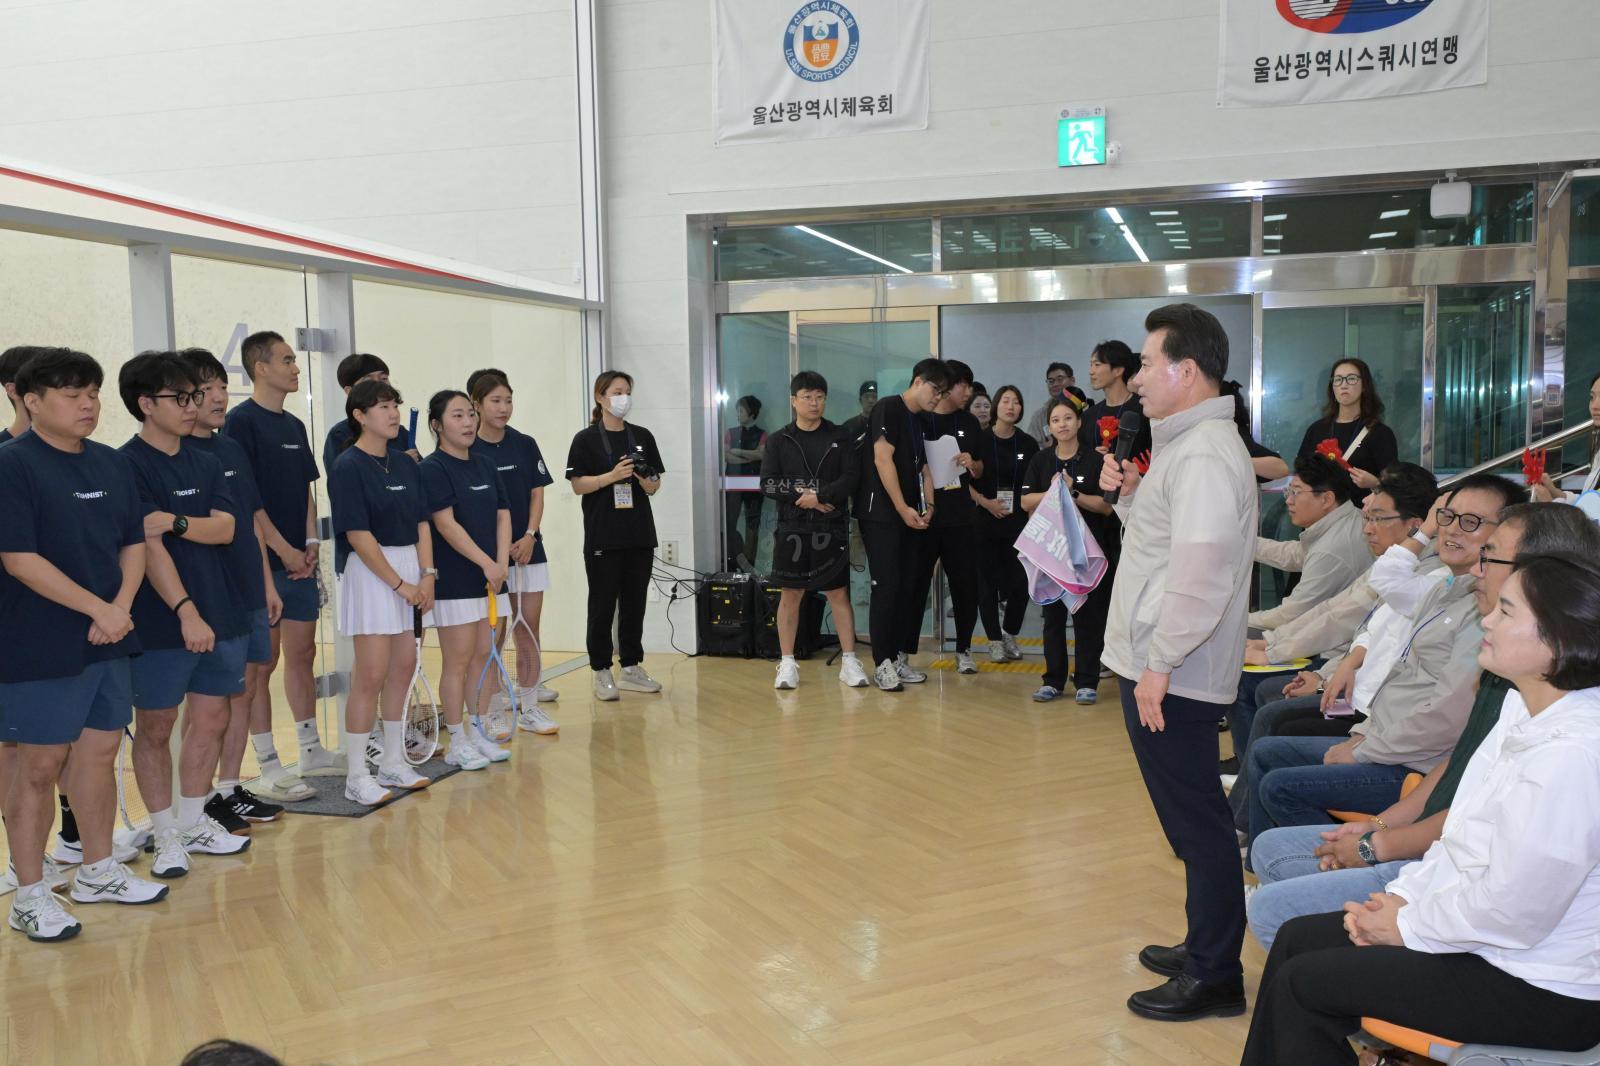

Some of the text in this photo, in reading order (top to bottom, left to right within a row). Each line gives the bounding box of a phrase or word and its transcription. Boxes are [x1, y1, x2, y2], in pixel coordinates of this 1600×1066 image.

[785, 41, 858, 81] ULSAN SPORTS COUNCIL
[1253, 35, 1459, 83] 울산광역시스쿼시연맹
[752, 93, 893, 126] 울산광역시체육회
